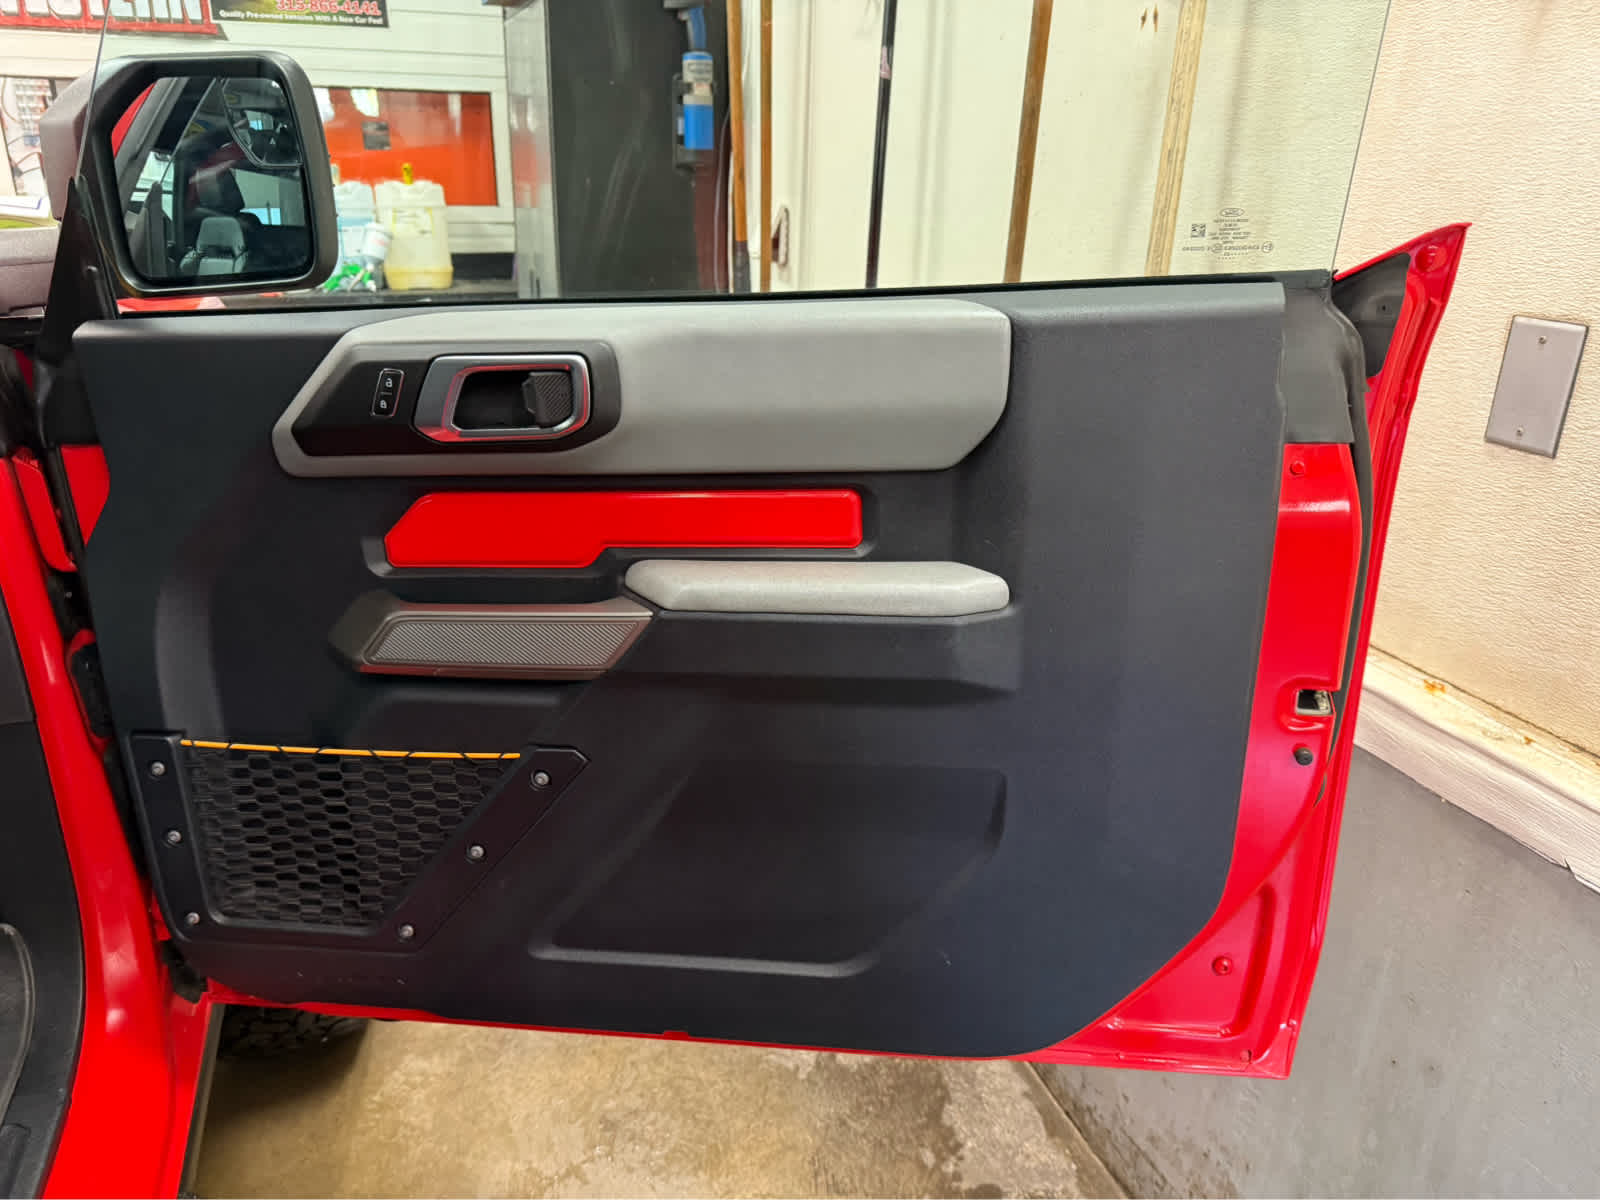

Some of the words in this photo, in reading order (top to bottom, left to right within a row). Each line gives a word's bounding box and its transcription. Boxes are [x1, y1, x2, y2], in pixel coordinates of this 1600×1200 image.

[218, 9, 244, 20] Quality
[246, 11, 283, 20] Pre-owned
[355, 16, 367, 24] Car
